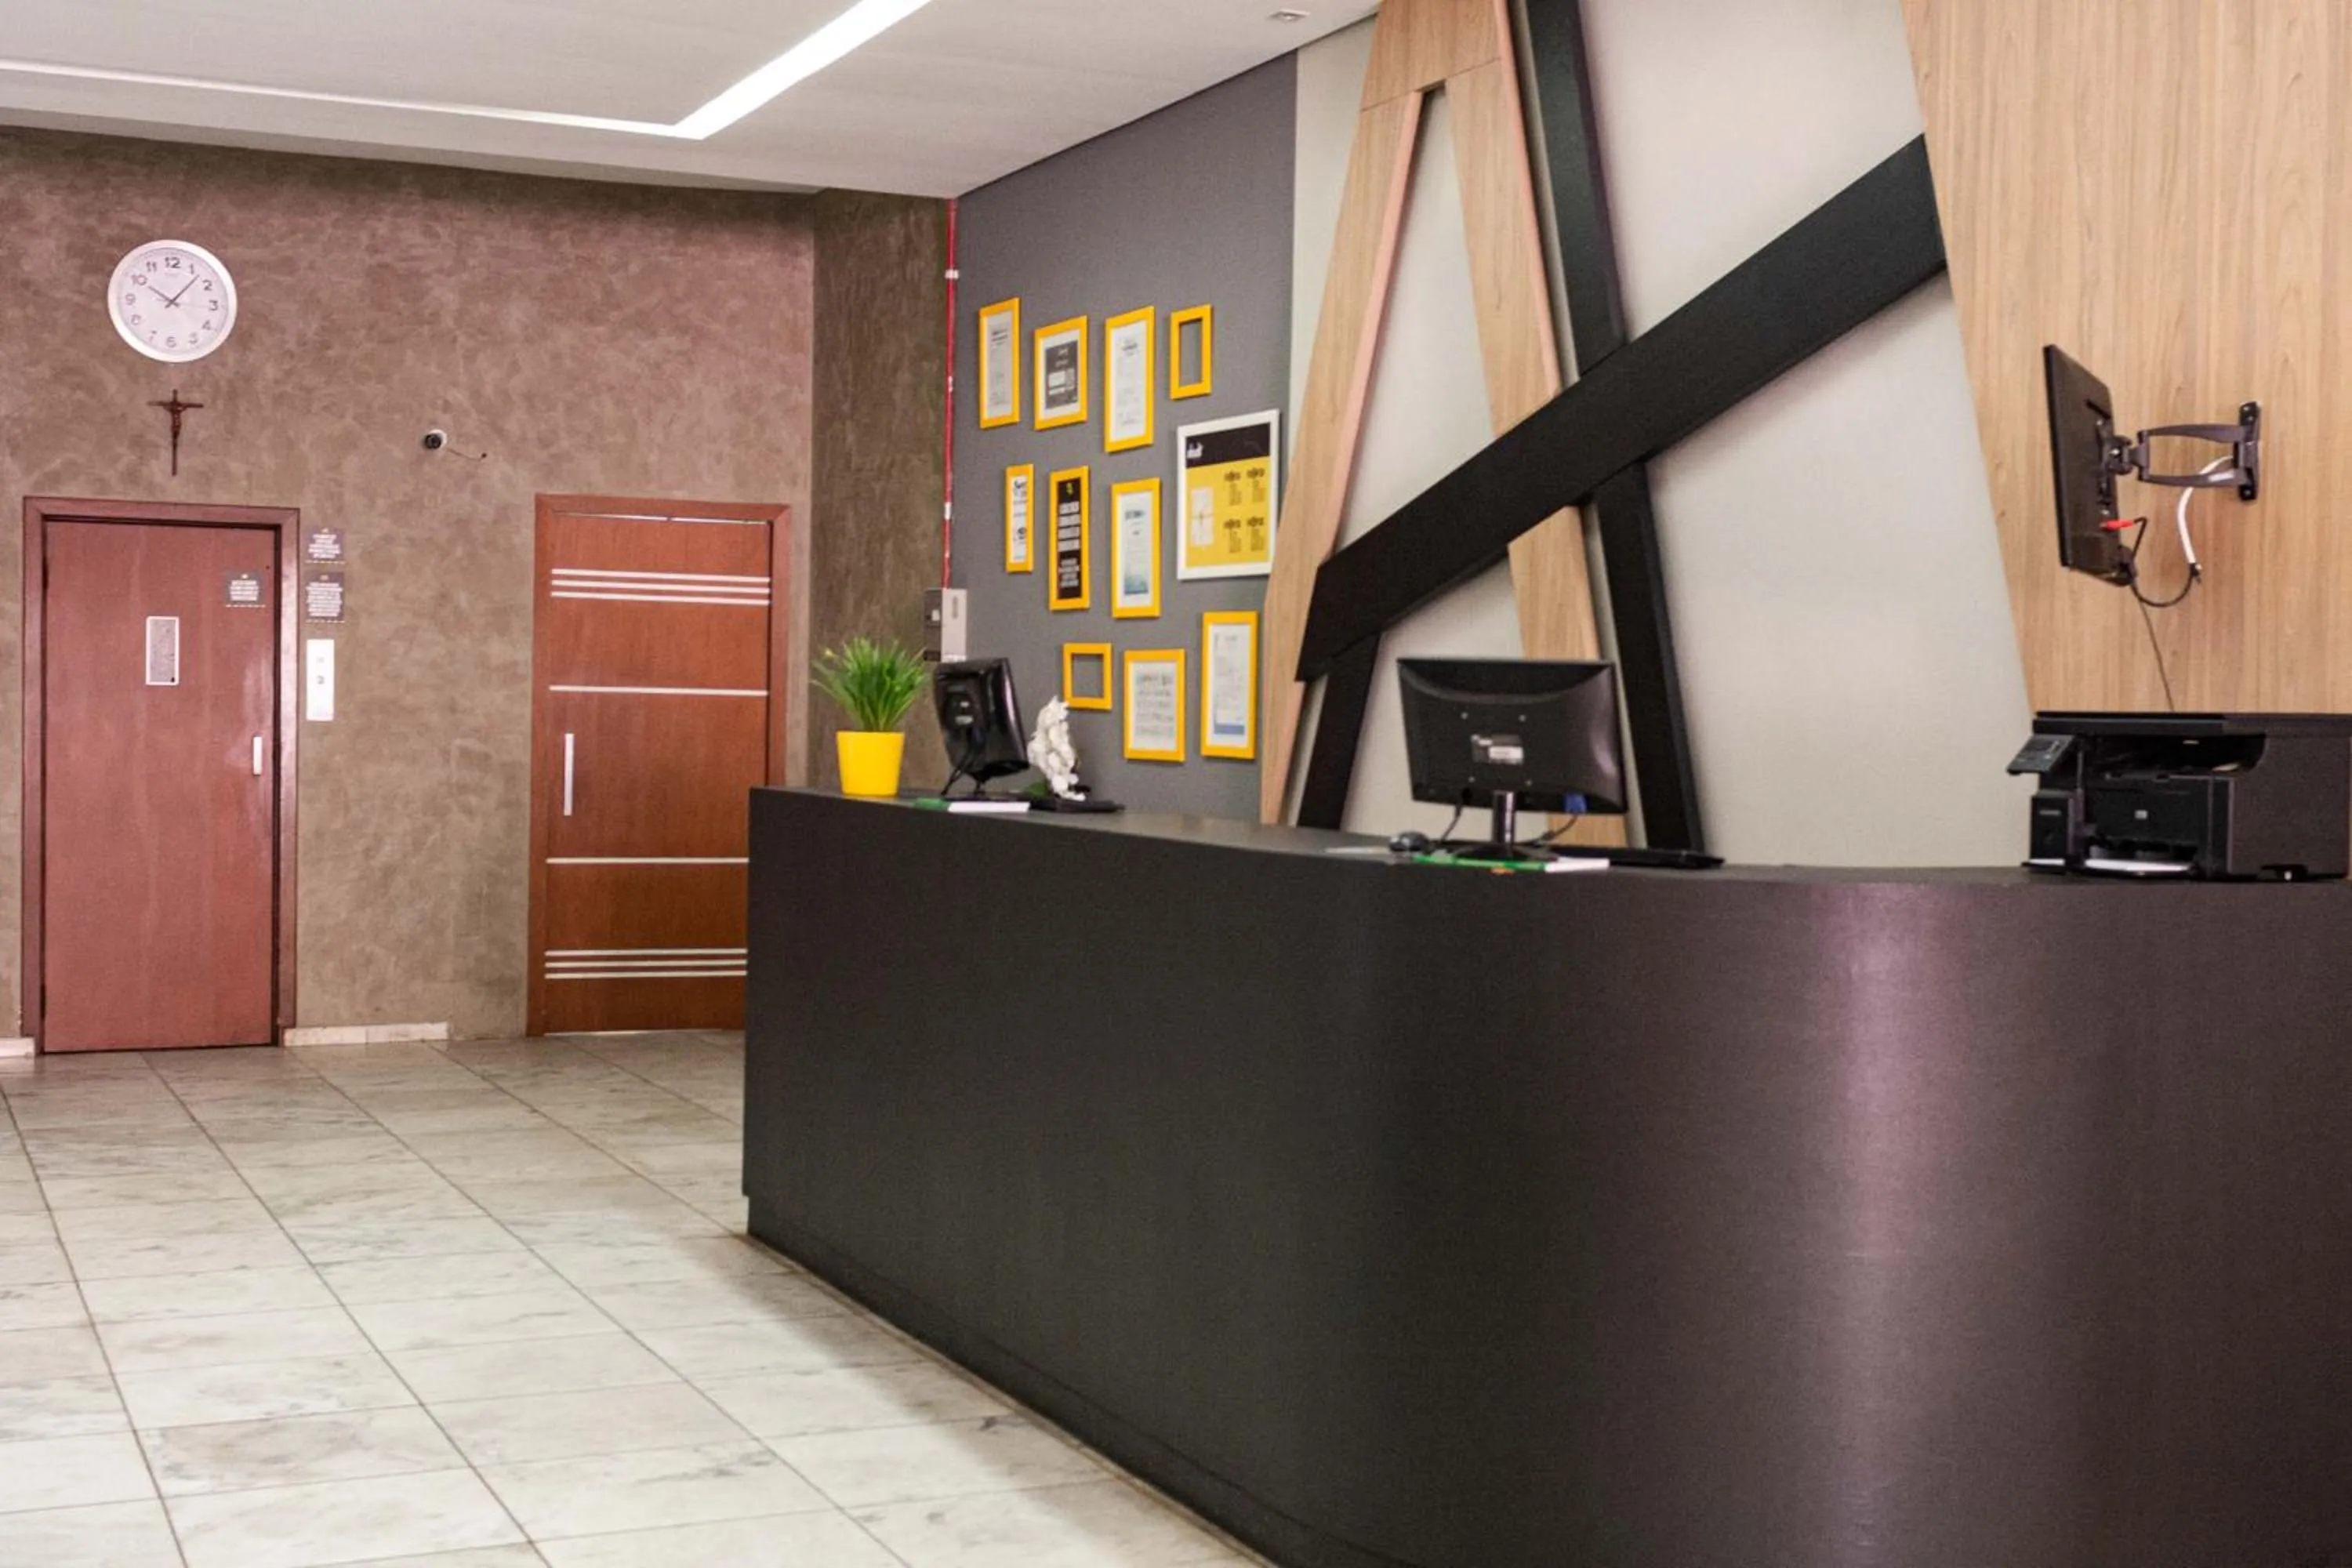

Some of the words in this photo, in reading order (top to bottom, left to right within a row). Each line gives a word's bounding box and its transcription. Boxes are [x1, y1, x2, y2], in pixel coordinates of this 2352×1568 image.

[146, 261, 158, 272] 11
[165, 256, 181, 269] 12
[189, 264, 195, 275] 1
[132, 274, 147, 286] 10
[202, 279, 212, 291] 2
[125, 293, 136, 305] 9
[209, 299, 219, 310] 3
[201, 320, 212, 331] 4
[165, 336, 176, 347] 6
